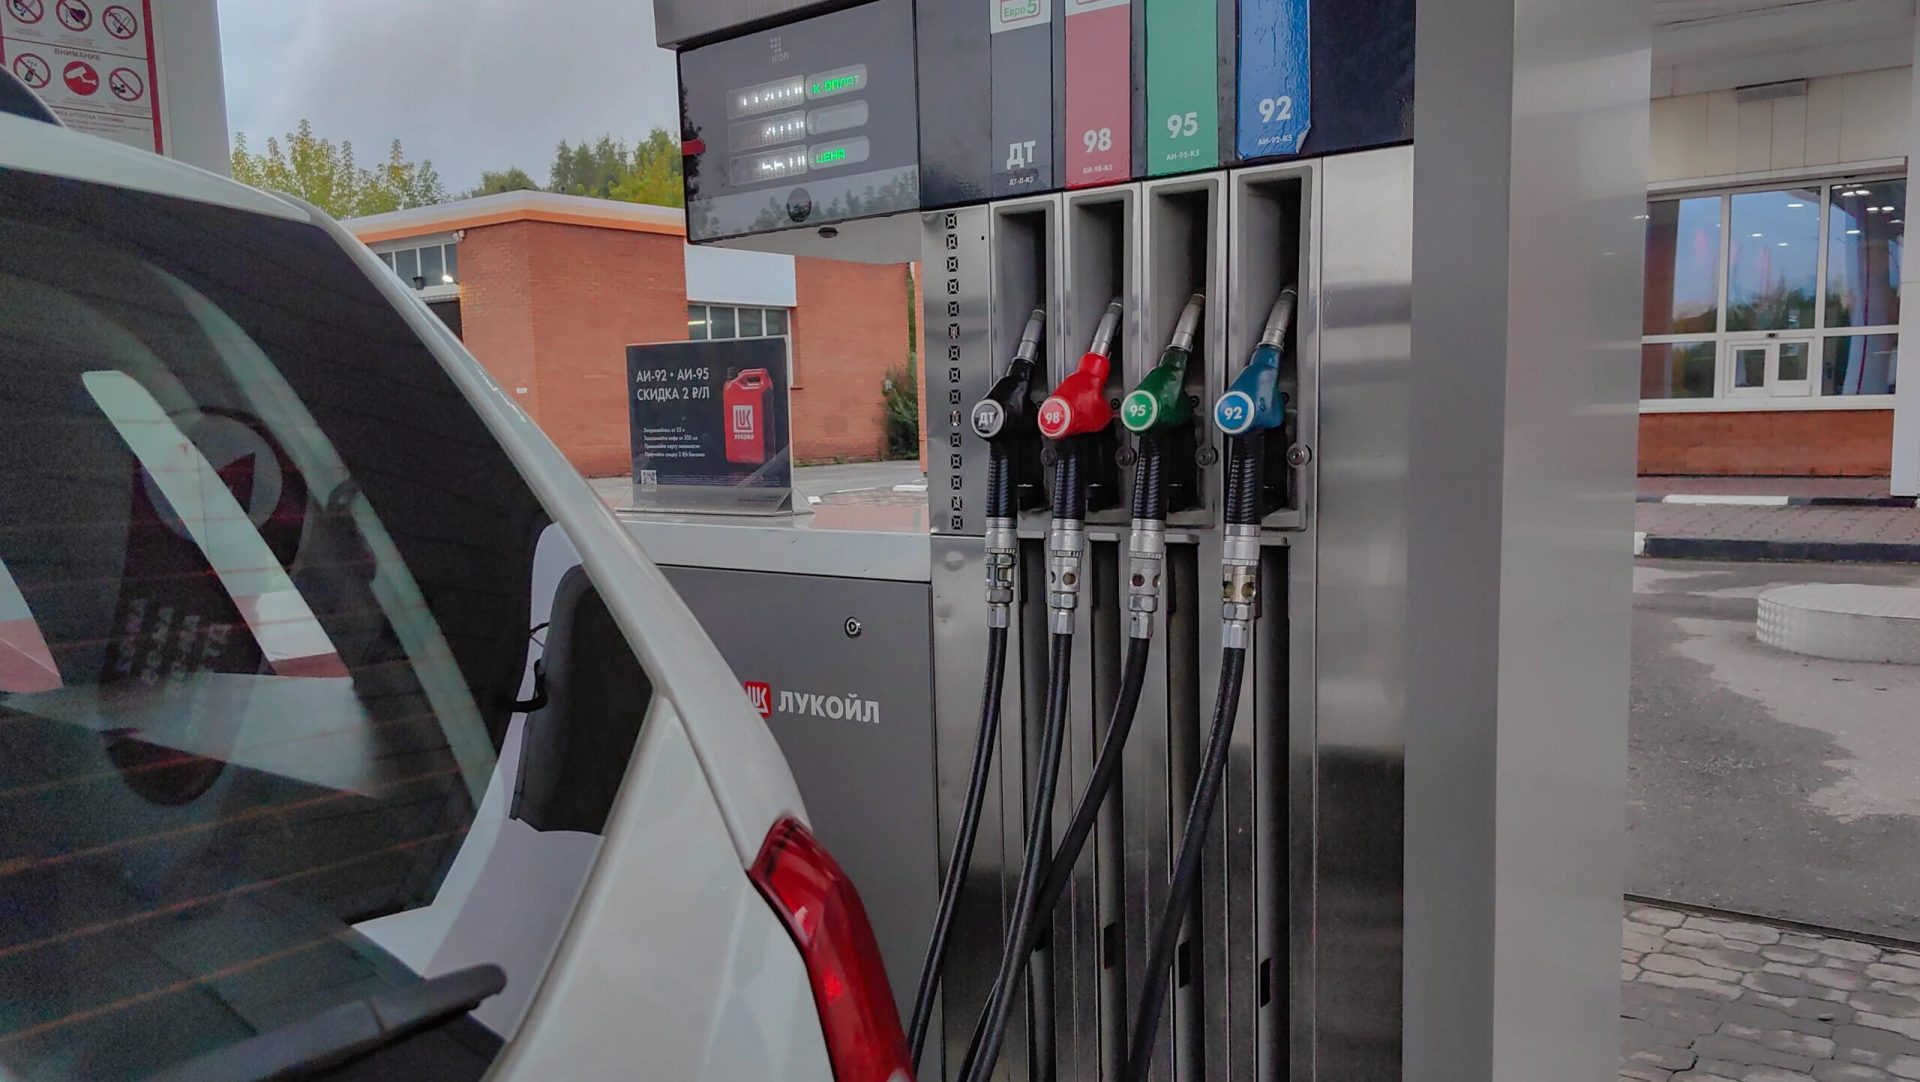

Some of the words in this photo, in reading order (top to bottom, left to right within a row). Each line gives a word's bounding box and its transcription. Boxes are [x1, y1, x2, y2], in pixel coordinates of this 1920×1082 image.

[1003, 7, 1026, 18] Евро
[54, 47, 100, 61] ВНИМАНИЕ
[812, 83, 821, 93] К
[1258, 95, 1292, 123] 92
[1166, 112, 1199, 139] 95
[1083, 127, 1112, 153] 98
[1257, 134, 1294, 147] АИ-92-К5
[815, 147, 846, 164] ЦЕНА
[1006, 140, 1036, 170] ДТ
[1166, 148, 1200, 161] АИ-95-К5
[636, 368, 668, 383] АИ-92
[677, 367, 710, 381] АИ-95
[636, 387, 680, 402] СКИДКА
[683, 387, 690, 400] 2
[1045, 411, 1060, 425] 98
[1129, 404, 1147, 417] 95
[1224, 406, 1243, 421] 92
[978, 411, 995, 427] ДТ
[777, 690, 880, 724] ЛУКОЙЛ
